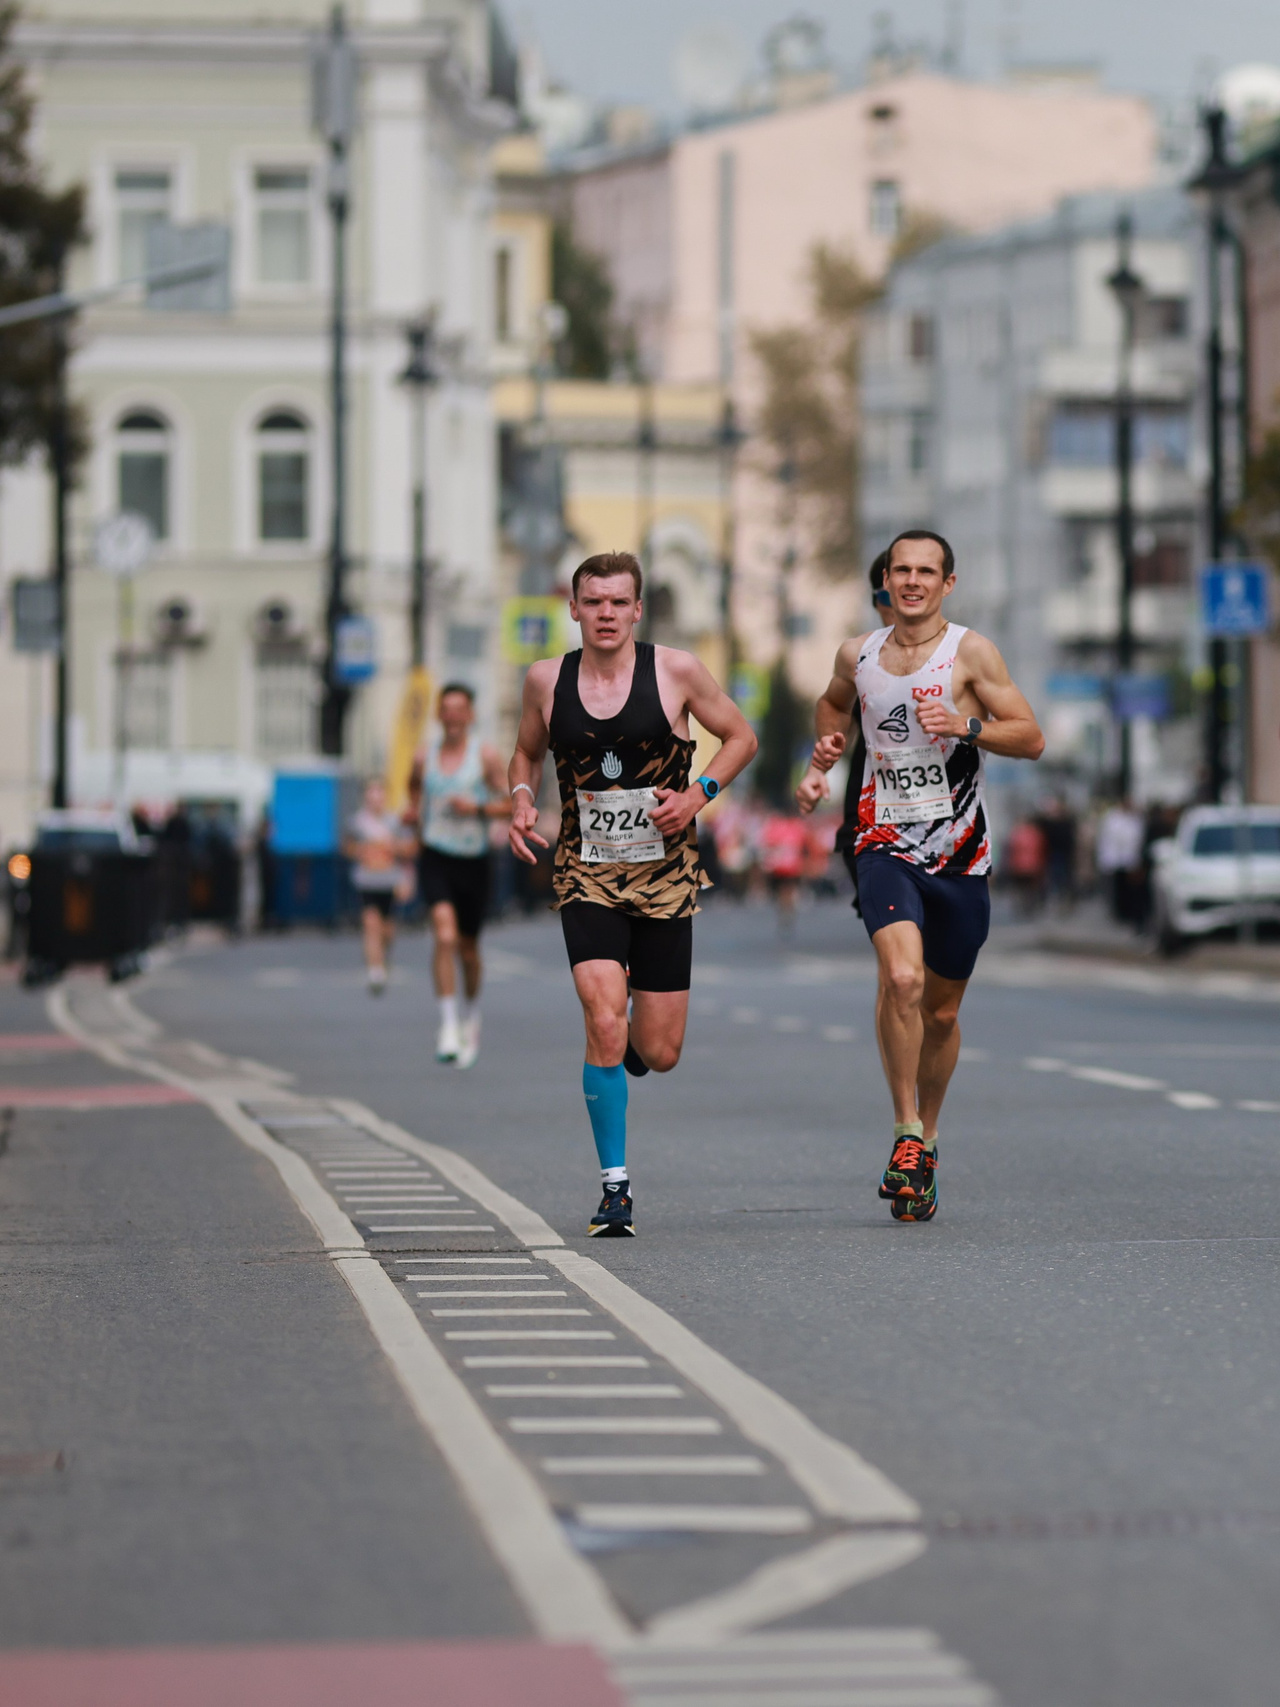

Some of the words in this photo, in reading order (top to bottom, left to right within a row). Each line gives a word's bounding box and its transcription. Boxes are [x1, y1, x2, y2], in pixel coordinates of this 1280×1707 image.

[877, 764, 944, 791] 19533
[589, 808, 650, 832] 2924
[881, 807, 891, 820] A
[605, 833, 633, 841] АНДРЕЙ
[589, 845, 599, 858] A
